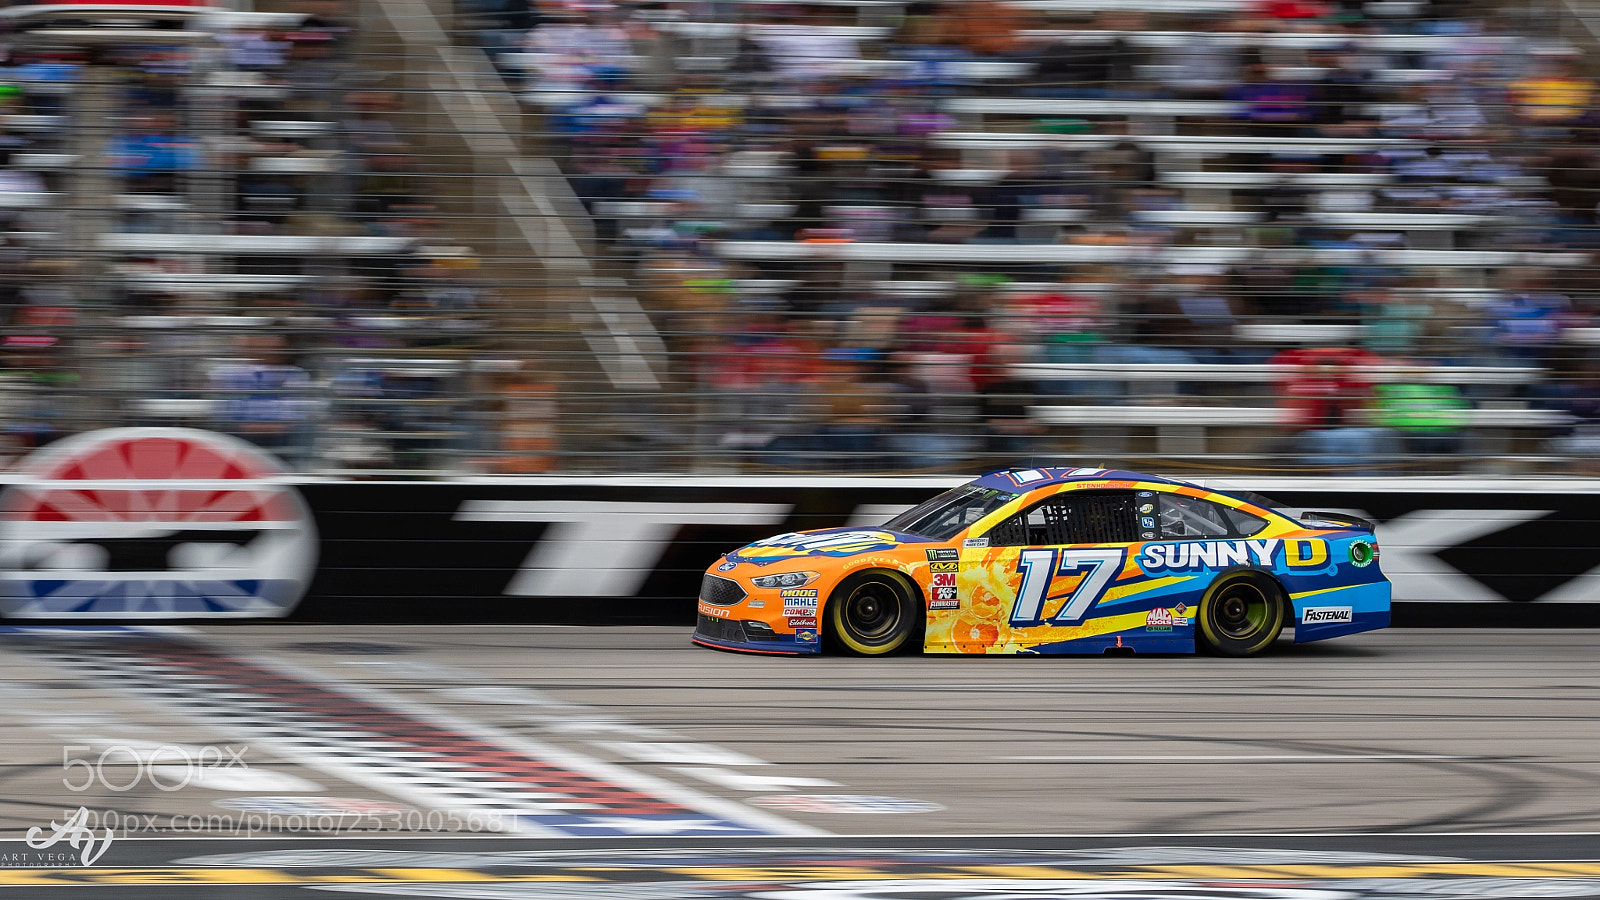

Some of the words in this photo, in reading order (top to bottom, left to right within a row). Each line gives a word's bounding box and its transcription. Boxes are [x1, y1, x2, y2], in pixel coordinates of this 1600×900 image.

[1142, 538, 1328, 568] SUNNYD
[843, 556, 898, 569] GOODYEAR
[933, 573, 956, 586] 3M
[1011, 549, 1123, 622] 17
[784, 598, 817, 606] MAHLE
[1147, 608, 1172, 620] MAC
